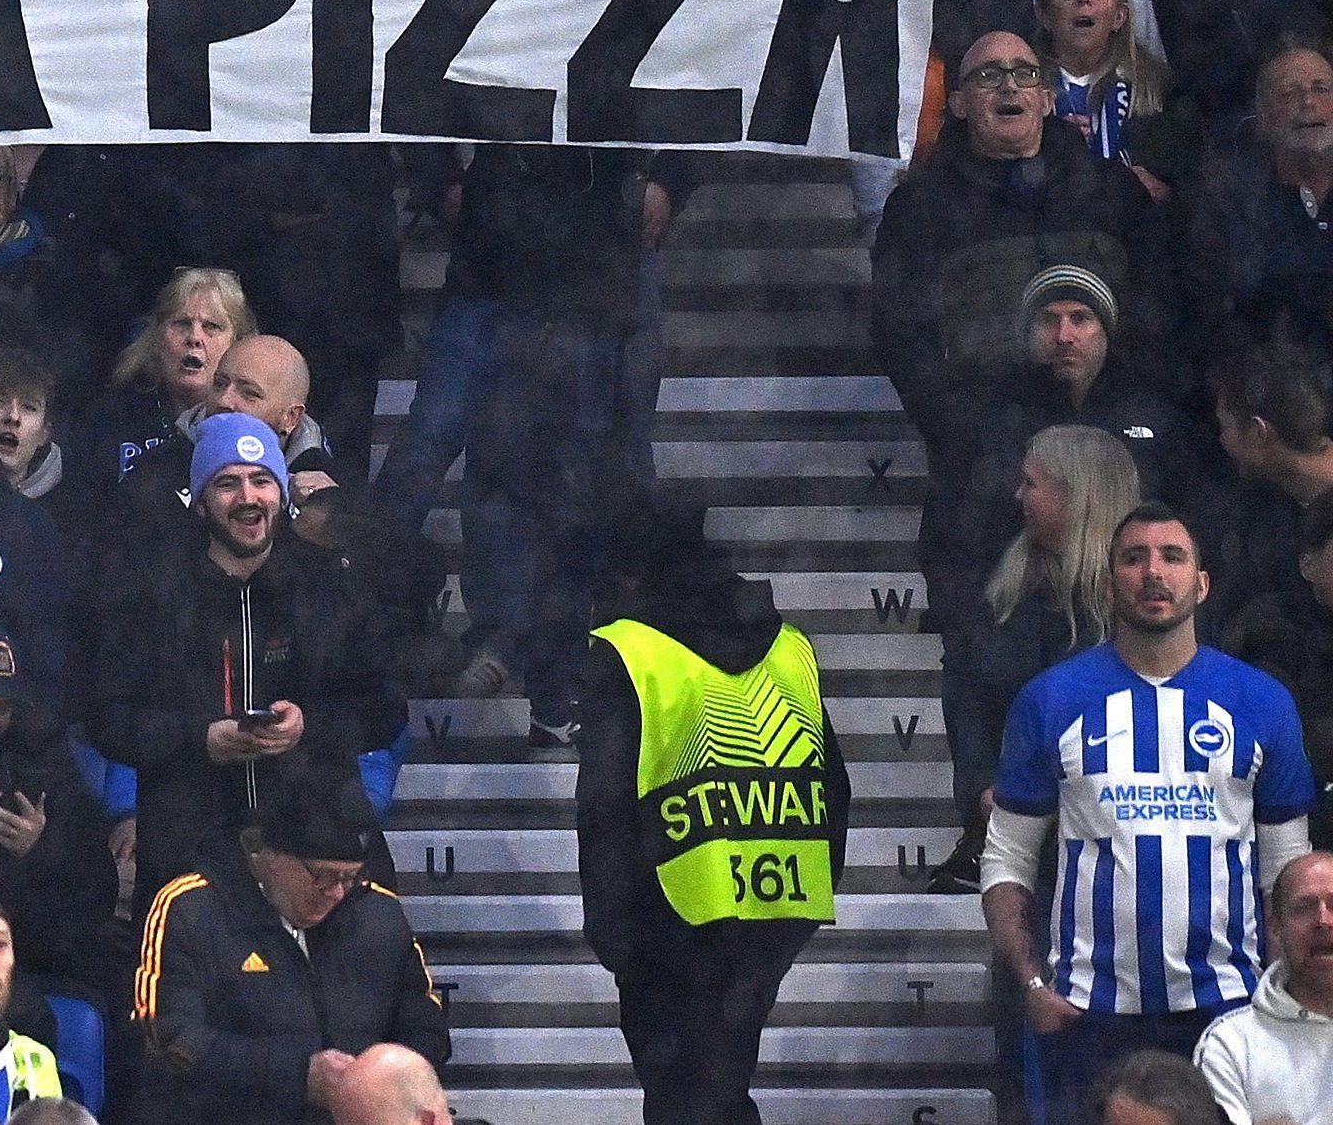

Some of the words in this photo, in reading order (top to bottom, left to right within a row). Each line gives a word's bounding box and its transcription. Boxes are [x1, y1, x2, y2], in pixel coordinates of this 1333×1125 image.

[871, 589, 914, 624] W
[424, 715, 452, 751] V
[892, 715, 919, 751] V
[660, 780, 829, 842] STWAR
[1098, 784, 1215, 803] AMERICAN
[1115, 803, 1218, 822] EXPRESS
[427, 846, 454, 884] U
[898, 845, 926, 882] U
[907, 981, 934, 1020] T
